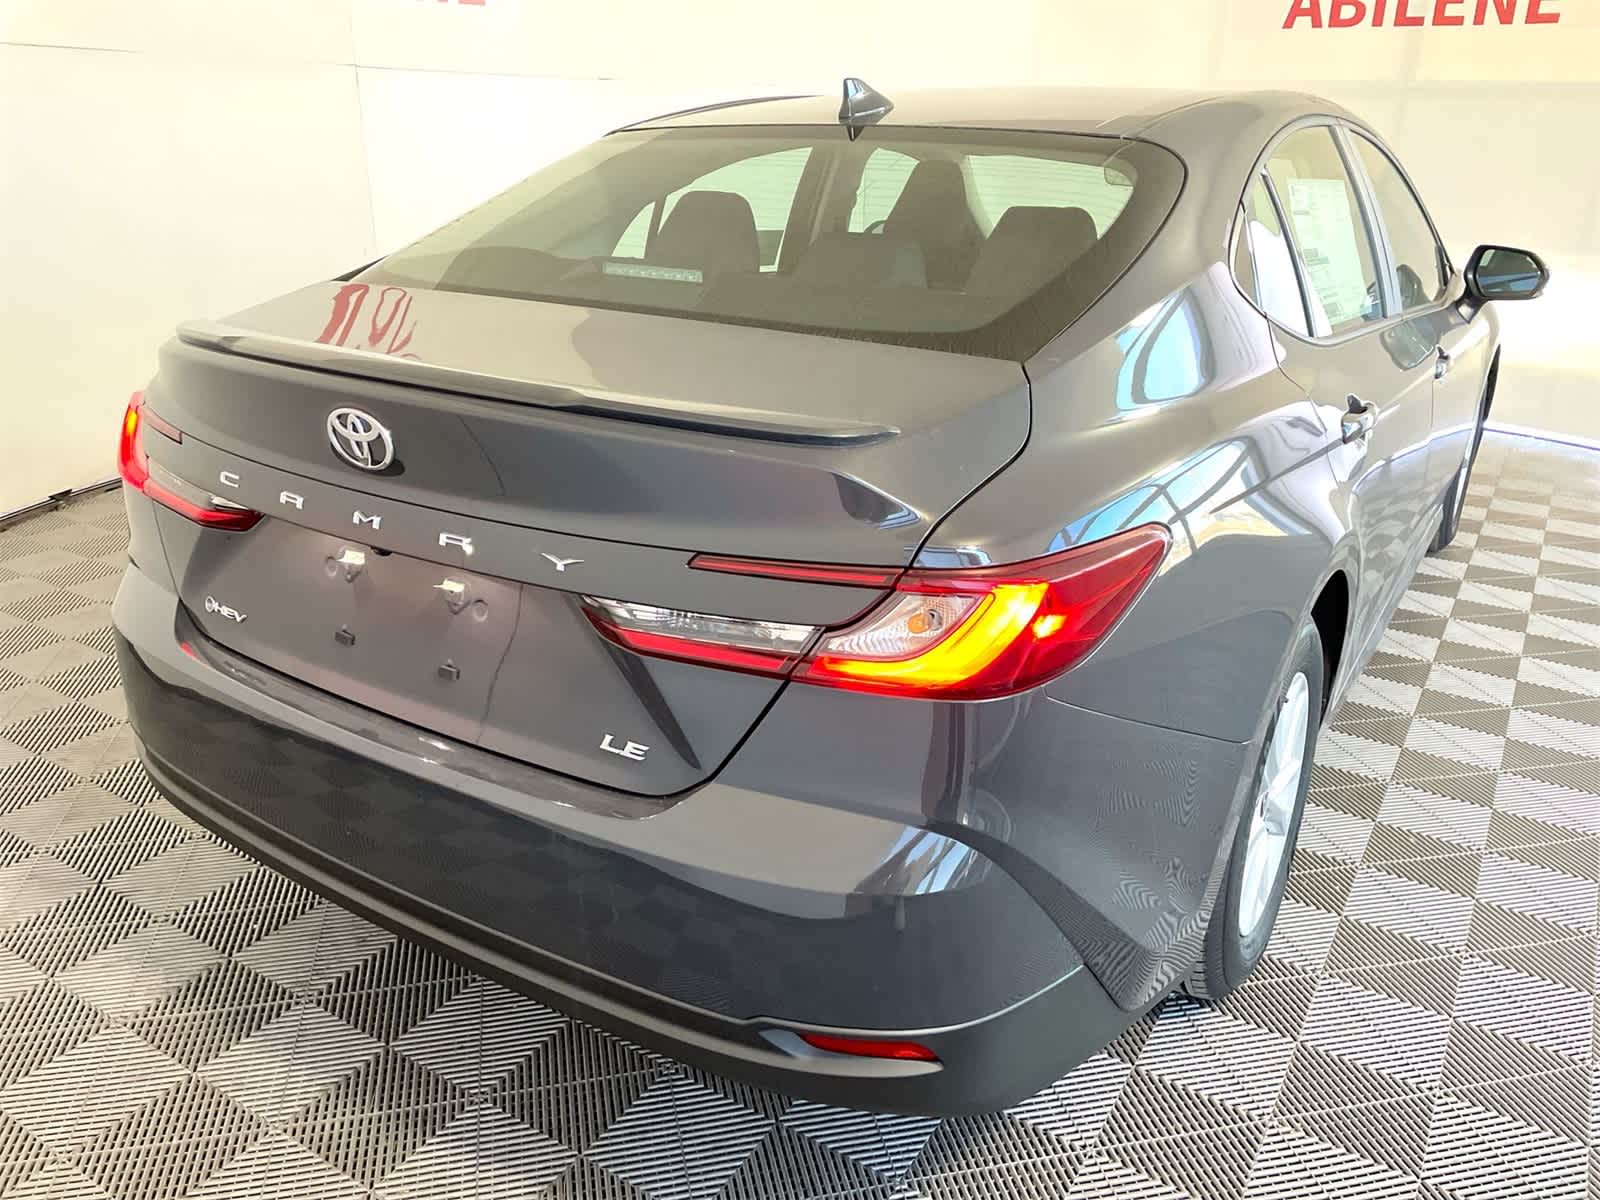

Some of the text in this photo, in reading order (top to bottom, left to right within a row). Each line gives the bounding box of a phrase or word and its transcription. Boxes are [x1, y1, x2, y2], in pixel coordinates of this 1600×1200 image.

[219, 470, 585, 572] CAMRY
[214, 601, 248, 623] HEV
[599, 733, 650, 761] LE
